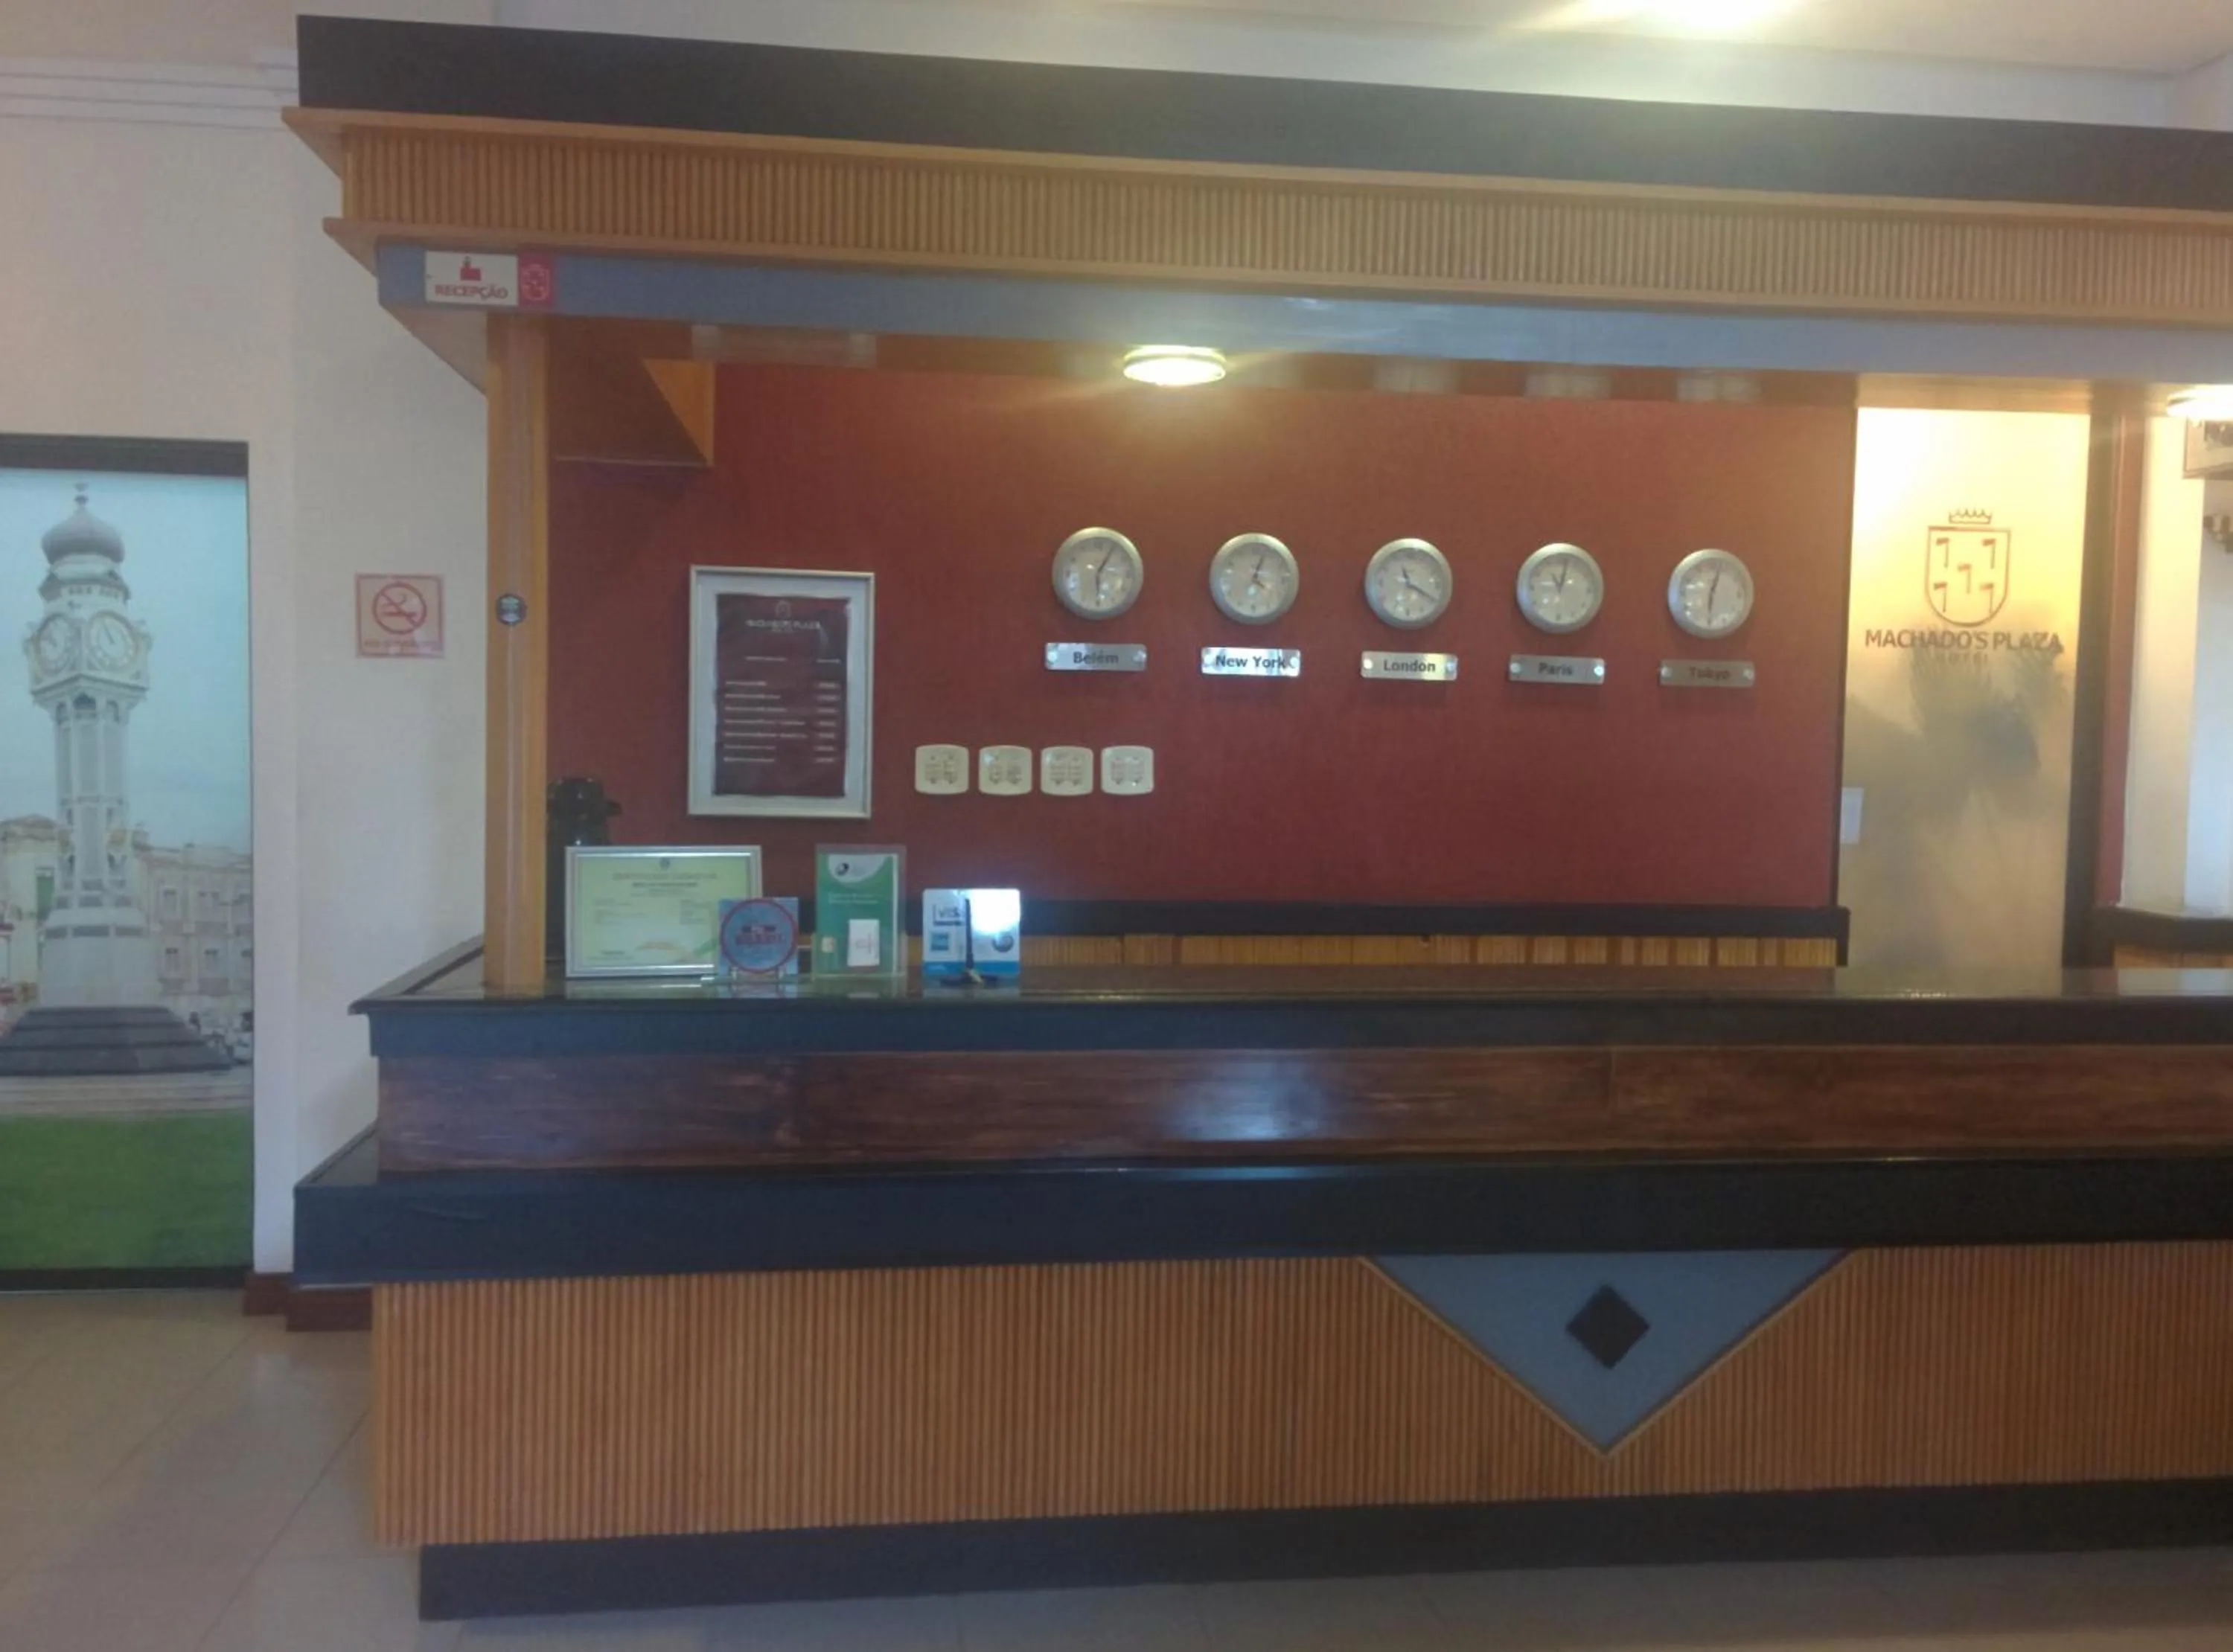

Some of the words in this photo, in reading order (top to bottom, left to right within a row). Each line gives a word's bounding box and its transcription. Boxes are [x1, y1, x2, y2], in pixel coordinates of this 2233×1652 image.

[434, 284, 508, 301] RECEPÇÃO
[1865, 630, 1989, 650] MACHADO'S
[1993, 632, 2063, 653] PLAZA
[1073, 650, 1119, 665] Belém
[1215, 655, 1248, 668] New
[1252, 656, 1286, 669] York
[1383, 659, 1436, 673] London
[1539, 662, 1574, 676] Paris
[1690, 666, 1730, 680] Tokyo
